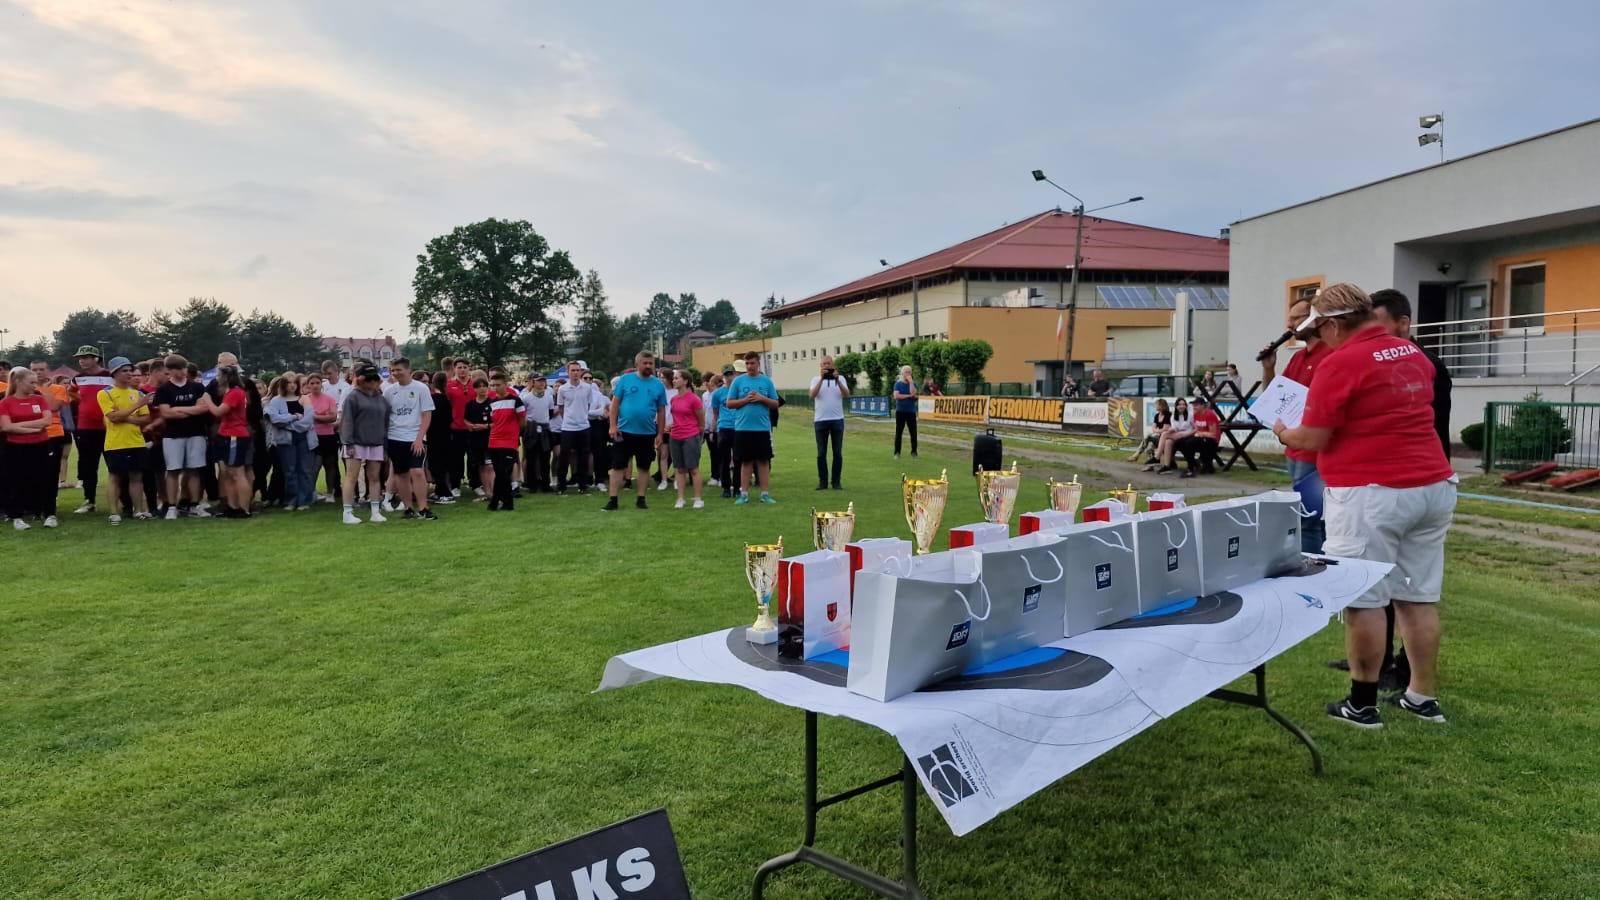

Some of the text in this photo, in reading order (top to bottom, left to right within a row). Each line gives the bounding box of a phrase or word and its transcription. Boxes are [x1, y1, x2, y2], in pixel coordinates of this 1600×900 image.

[1373, 345, 1418, 361] SĘDZIA
[934, 398, 987, 416] PRZEWIERTY
[989, 398, 1063, 423] STEROWANE
